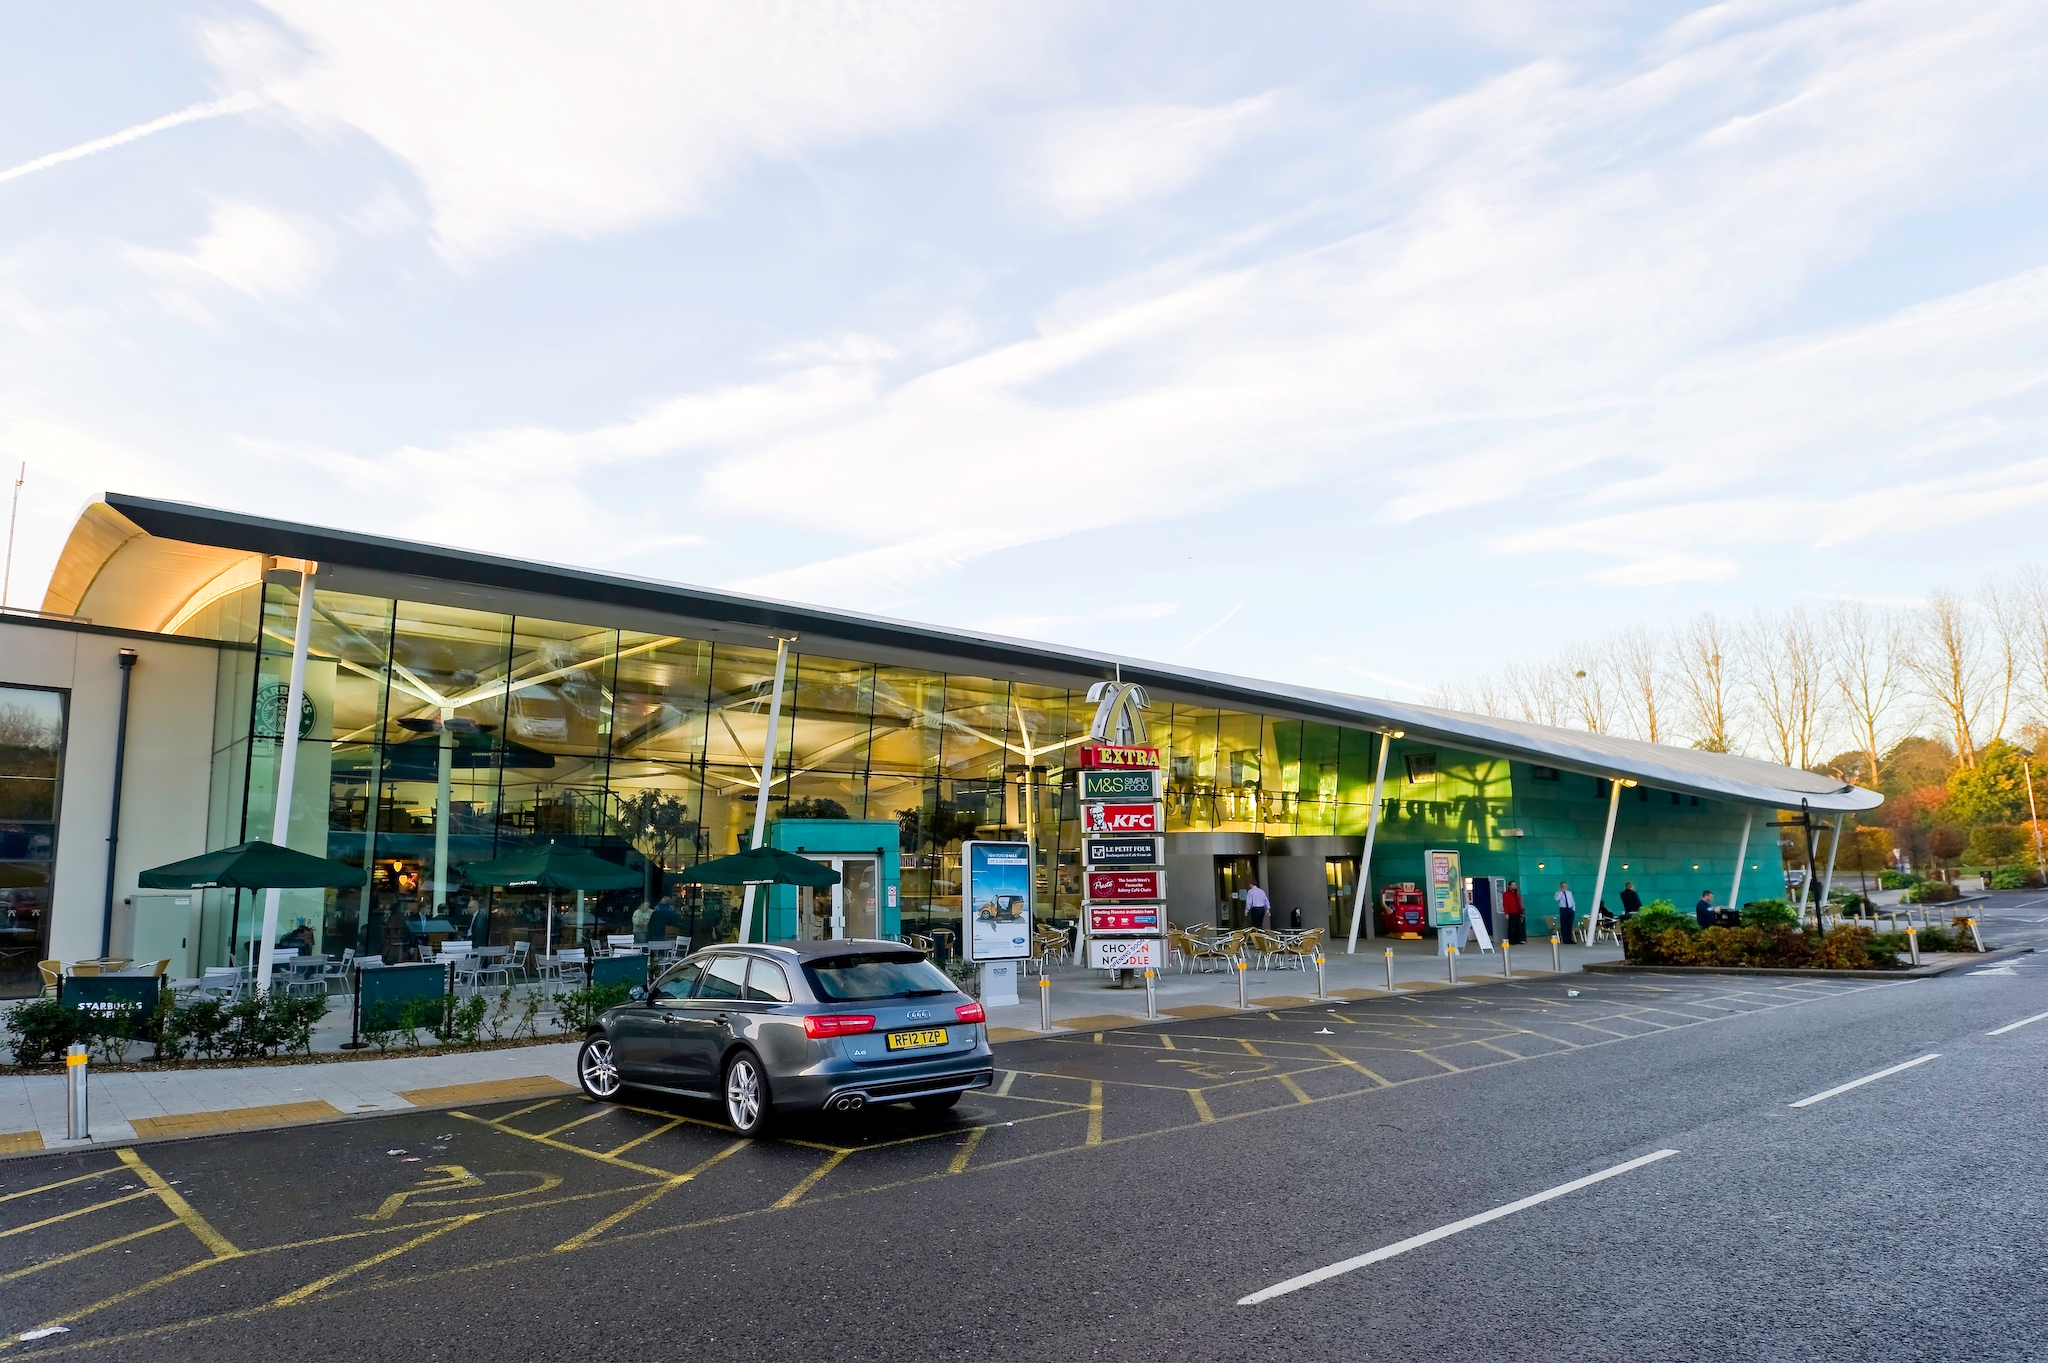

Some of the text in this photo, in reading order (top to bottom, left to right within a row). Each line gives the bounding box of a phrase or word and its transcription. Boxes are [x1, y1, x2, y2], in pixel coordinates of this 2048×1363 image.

[1100, 748, 1160, 766] EXTRA
[1088, 777, 1149, 793] M&S SIMPLY
[1124, 784, 1149, 792] FOOD
[1112, 814, 1153, 828] KFC
[1102, 944, 1149, 952] CHON
[1109, 950, 1132, 969] OPENING
[894, 1030, 941, 1046] RF12 TZP
